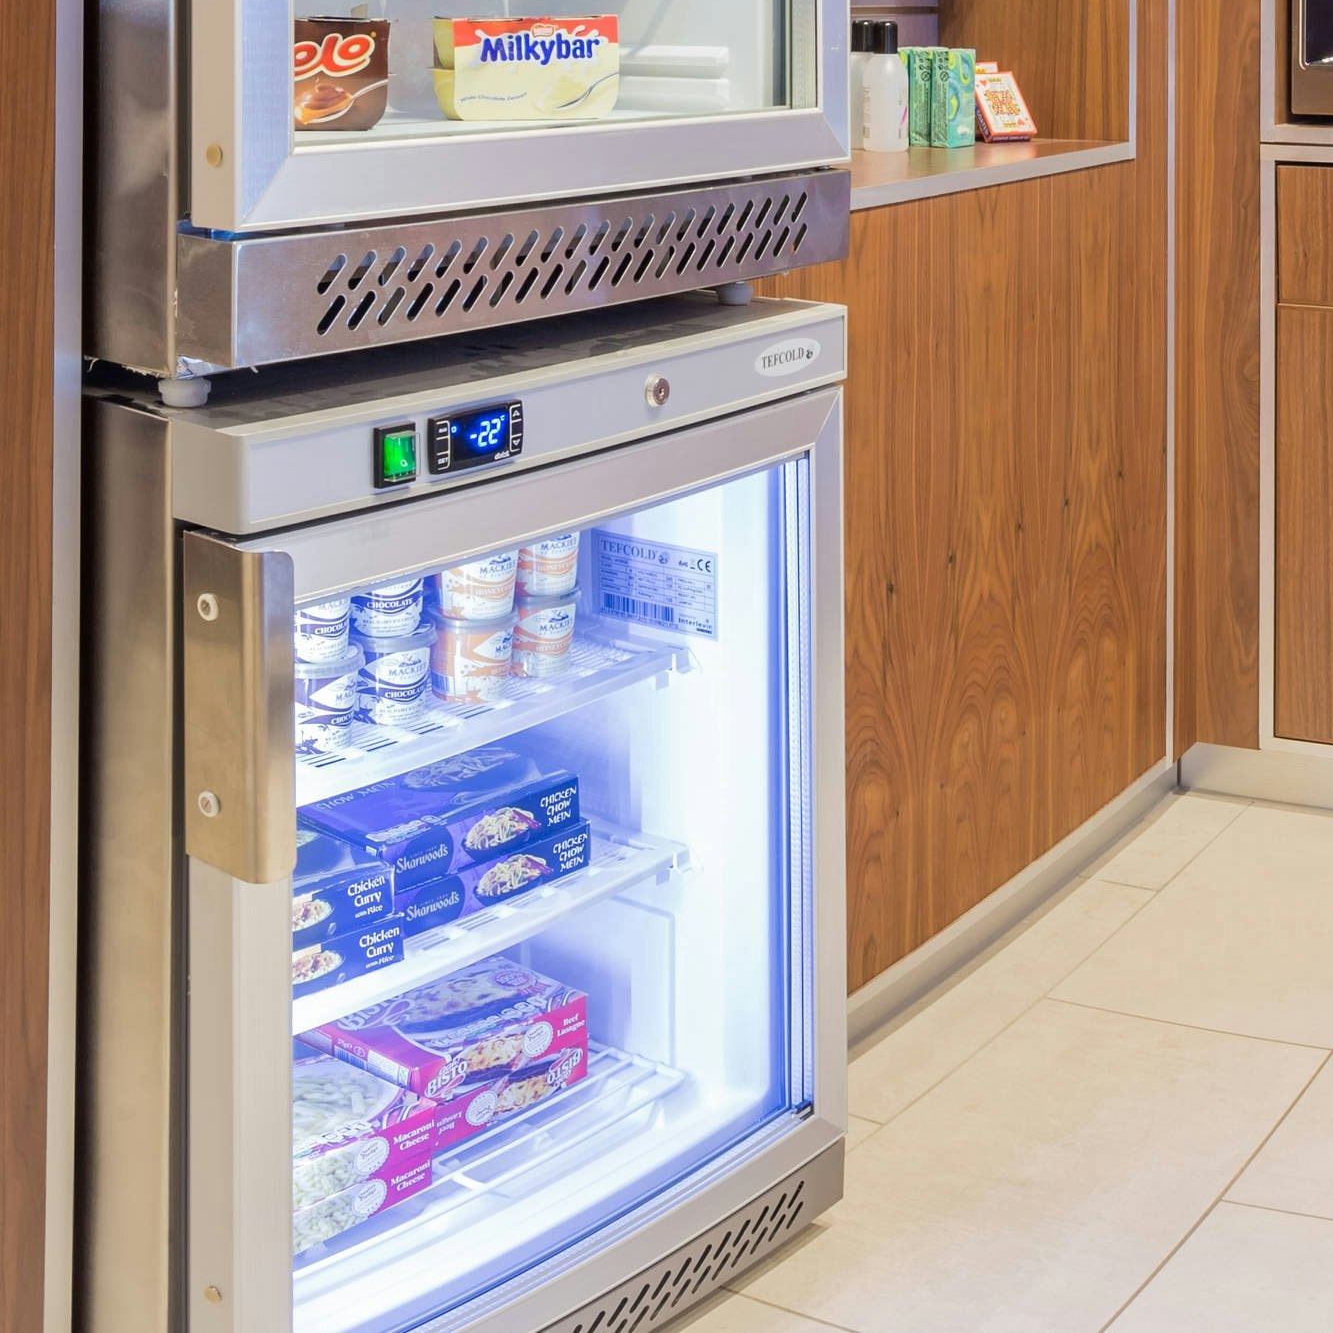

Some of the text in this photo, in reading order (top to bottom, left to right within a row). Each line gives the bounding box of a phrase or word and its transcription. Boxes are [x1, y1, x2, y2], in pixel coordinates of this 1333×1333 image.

[294, 34, 375, 76] olo
[480, 32, 601, 66] Milkybar
[761, 347, 804, 370] TEFCOLD
[470, 418, 501, 448] -22
[601, 540, 656, 560] TEFCOLD
[366, 597, 414, 610] CHOCOLATE
[679, 618, 712, 629] Interlevin
[540, 786, 578, 808] CHICKEN
[546, 798, 572, 816] CHOW
[548, 810, 572, 827] MEIN
[552, 832, 588, 854] CHICKEN
[394, 844, 449, 874] Sharwood's
[559, 844, 585, 863] CHOW
[560, 856, 584, 872] MEIN
[347, 874, 386, 897] Chicken
[354, 890, 382, 908] Curry
[406, 892, 460, 922] Sharwood's
[367, 904, 383, 916] Rice
[359, 927, 400, 948] Chicken
[366, 940, 394, 959] Curry
[378, 954, 395, 966] Rice
[426, 1060, 468, 1099] BISTO
[392, 1119, 436, 1146] Macaroni
[399, 1132, 430, 1152] Cheese
[390, 1160, 431, 1187] Macaroni
[396, 1172, 426, 1192] Cheese
